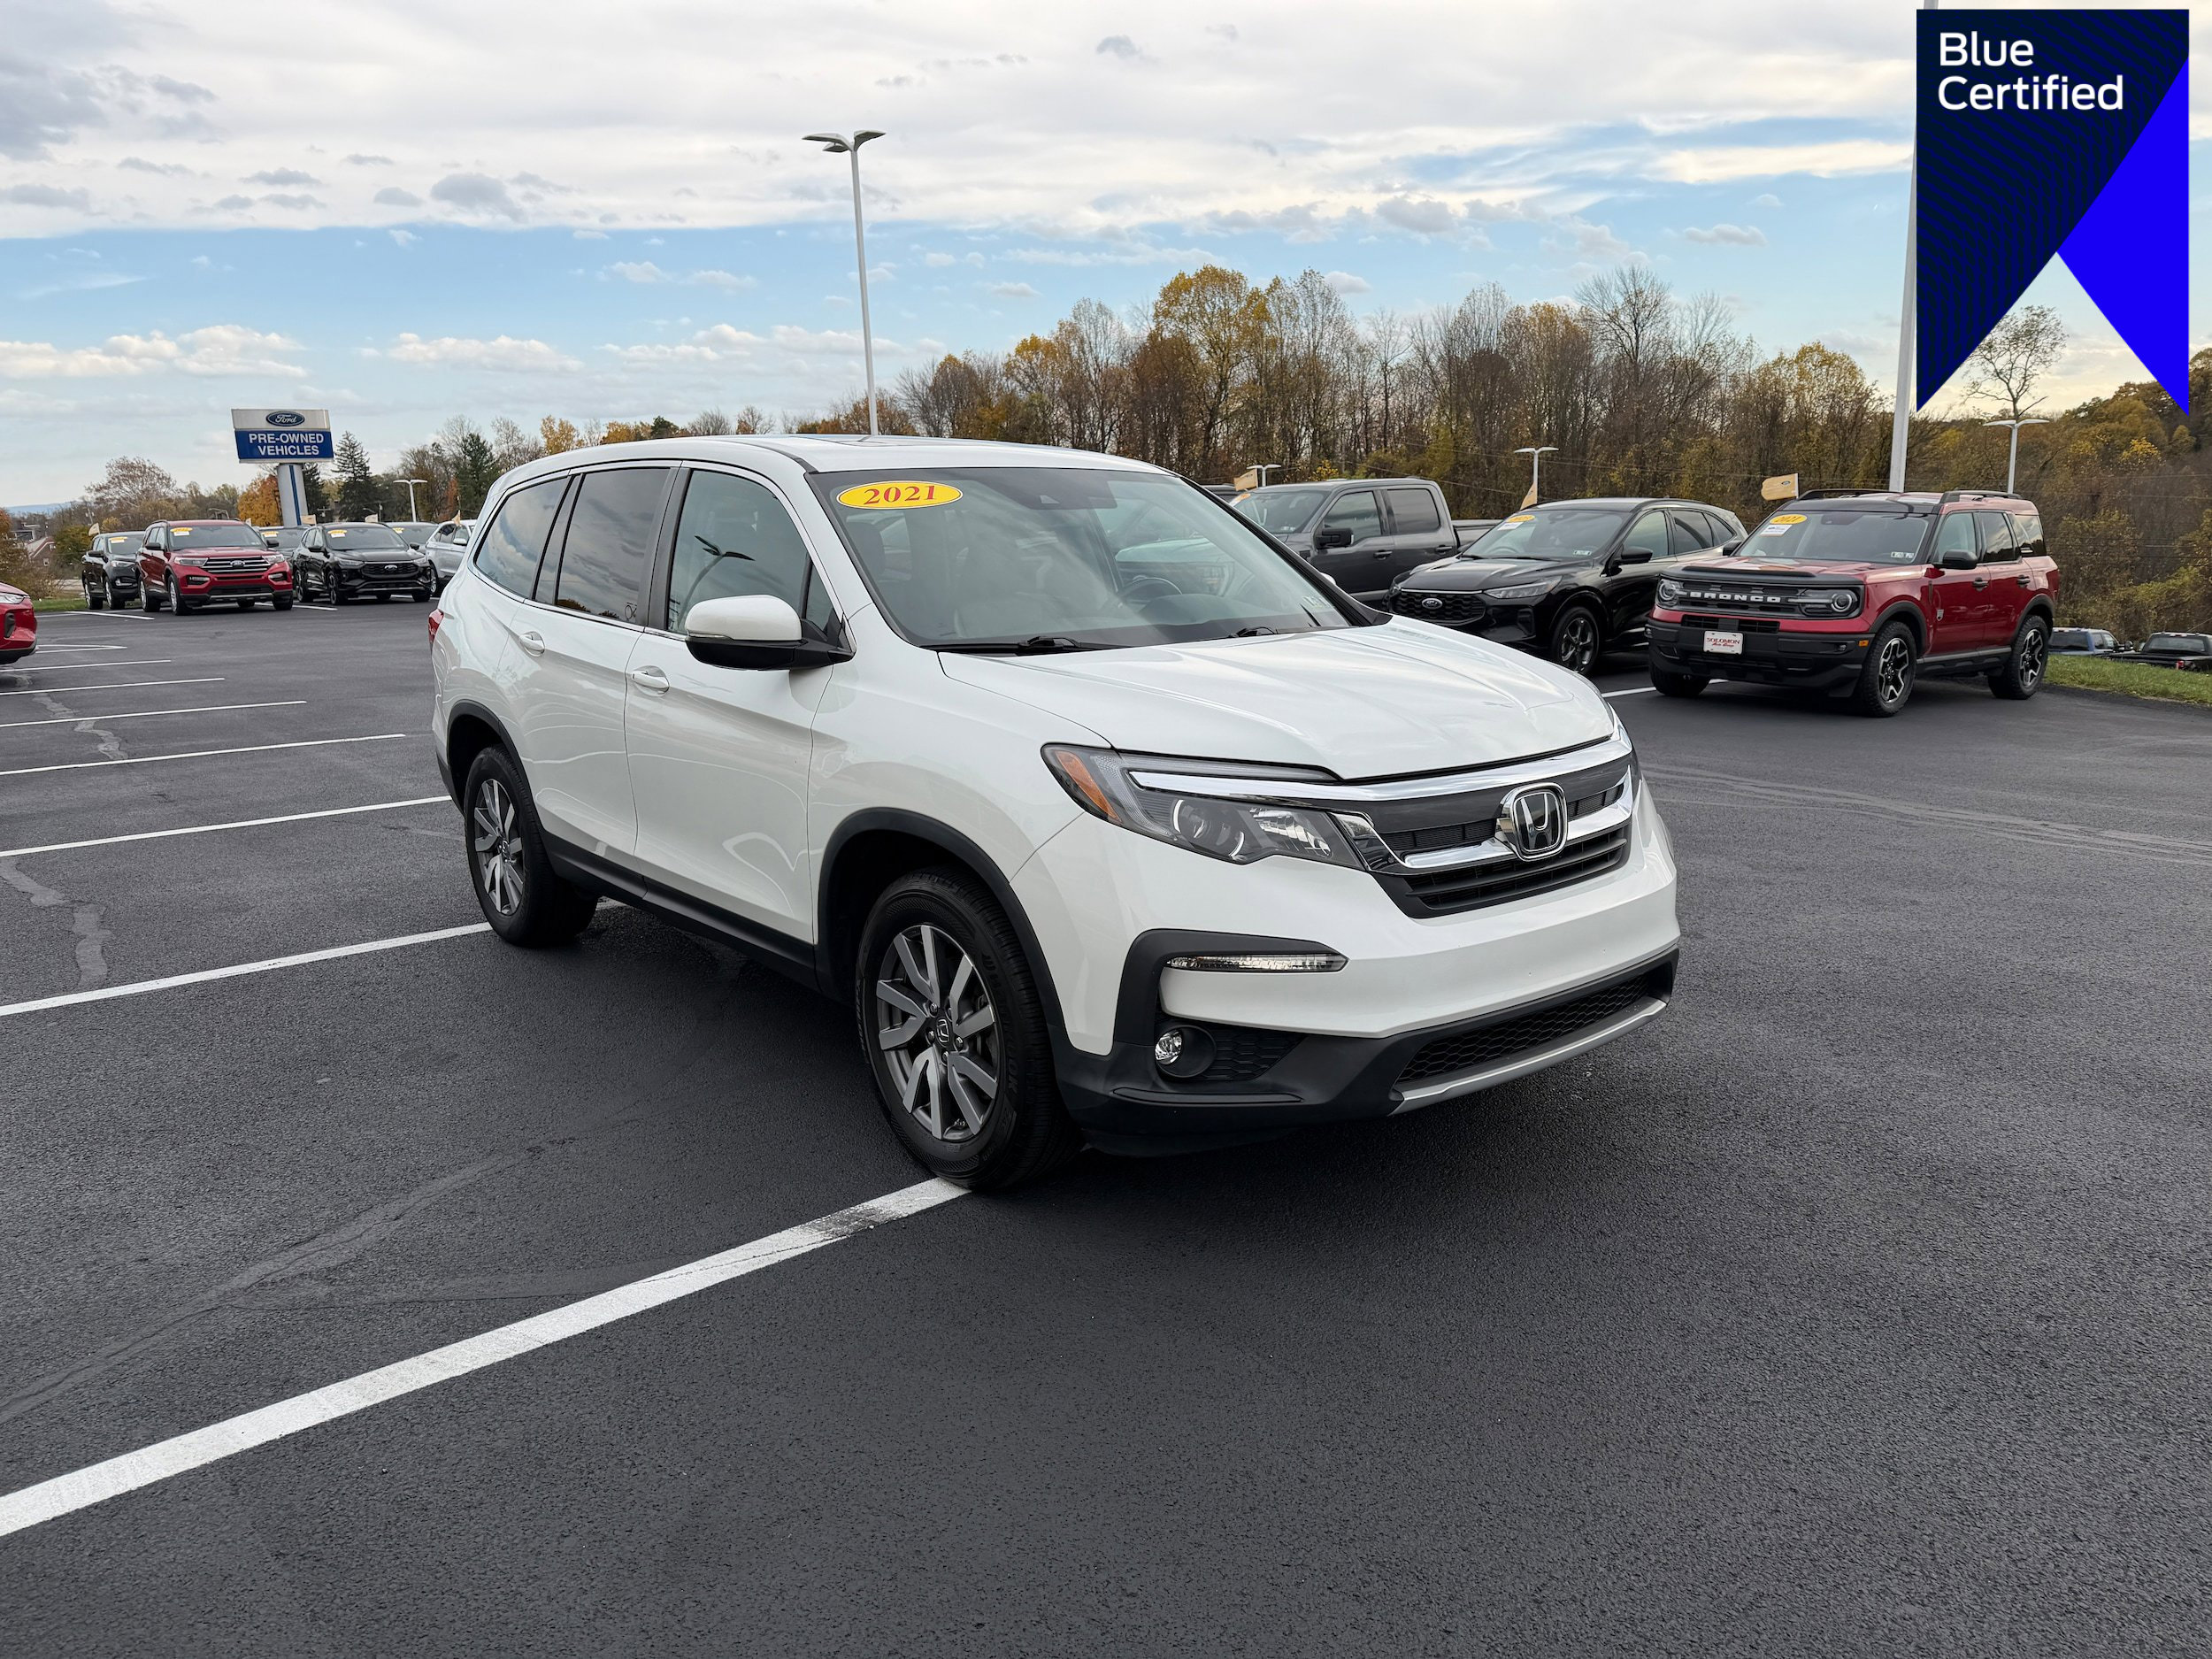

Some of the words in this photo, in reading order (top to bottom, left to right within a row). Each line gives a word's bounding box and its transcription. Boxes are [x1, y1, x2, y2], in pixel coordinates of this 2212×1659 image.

[274, 414, 297, 423] Ford
[249, 434, 324, 444] PRE-OWNED
[257, 444, 319, 456] VEHICLES
[864, 485, 936, 505] 2021
[1690, 591, 1781, 603] BRONCO
